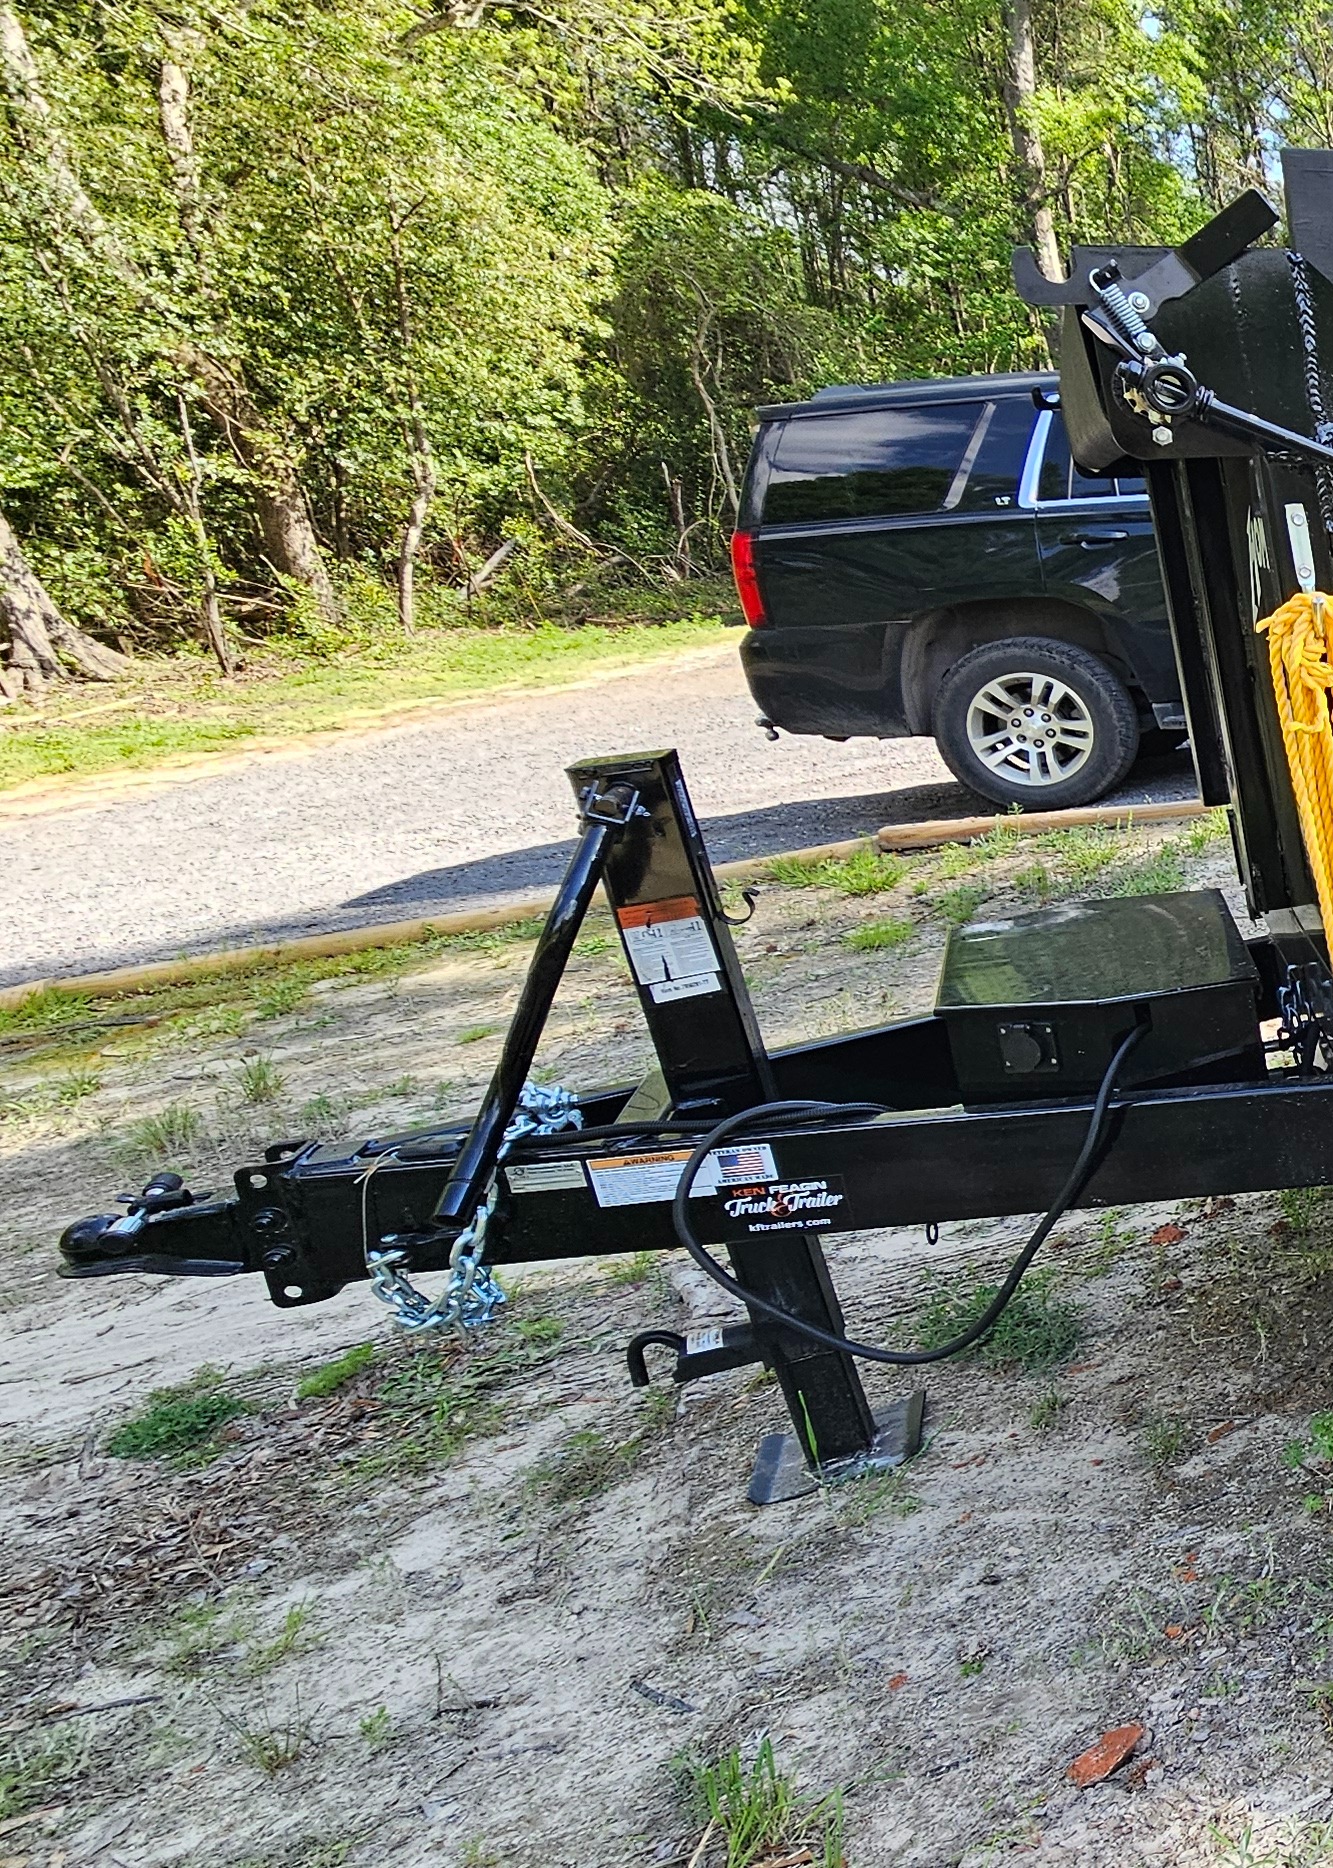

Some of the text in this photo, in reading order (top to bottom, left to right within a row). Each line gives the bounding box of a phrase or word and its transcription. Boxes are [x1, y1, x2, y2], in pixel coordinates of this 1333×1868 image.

[994, 496, 1011, 506] LT
[630, 1154, 675, 1165] WARNING
[717, 1176, 753, 1184] AMERICAN
[732, 1180, 828, 1197] KEN FEAGIN
[723, 1196, 777, 1217] Truck
[782, 1191, 843, 1212] Trailer
[748, 1218, 832, 1232] kftrailers.com
